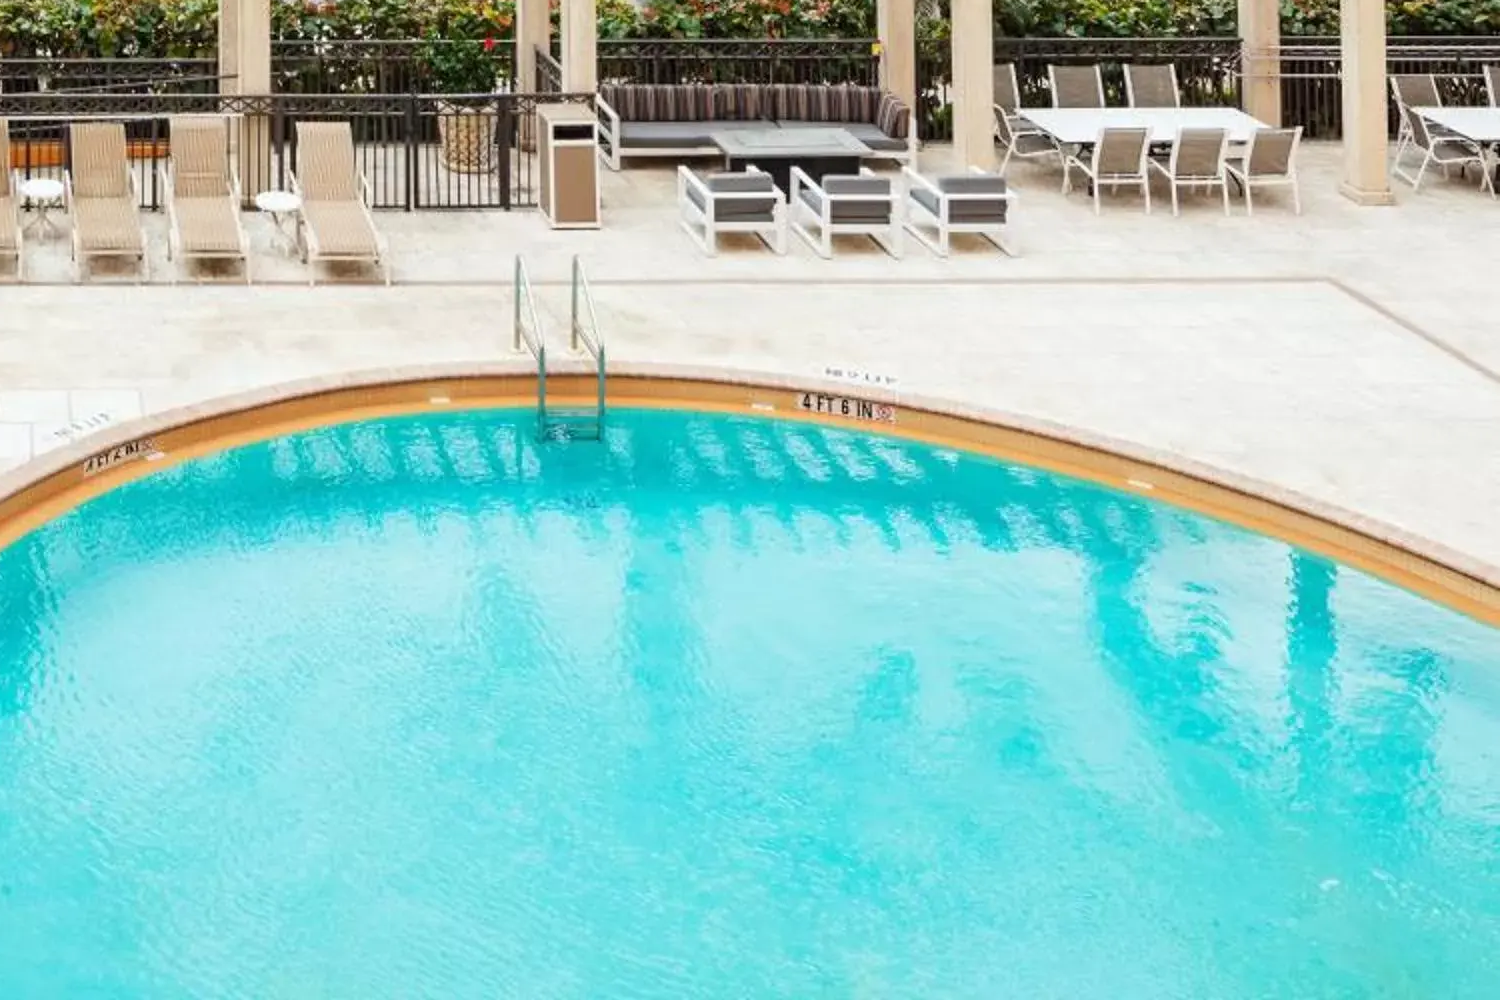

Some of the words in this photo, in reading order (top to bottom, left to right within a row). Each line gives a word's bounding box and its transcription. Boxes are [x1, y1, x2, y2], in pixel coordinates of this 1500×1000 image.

[802, 393, 811, 409] 4
[816, 395, 834, 413] FT
[841, 398, 850, 415] 6
[856, 399, 873, 418] IN
